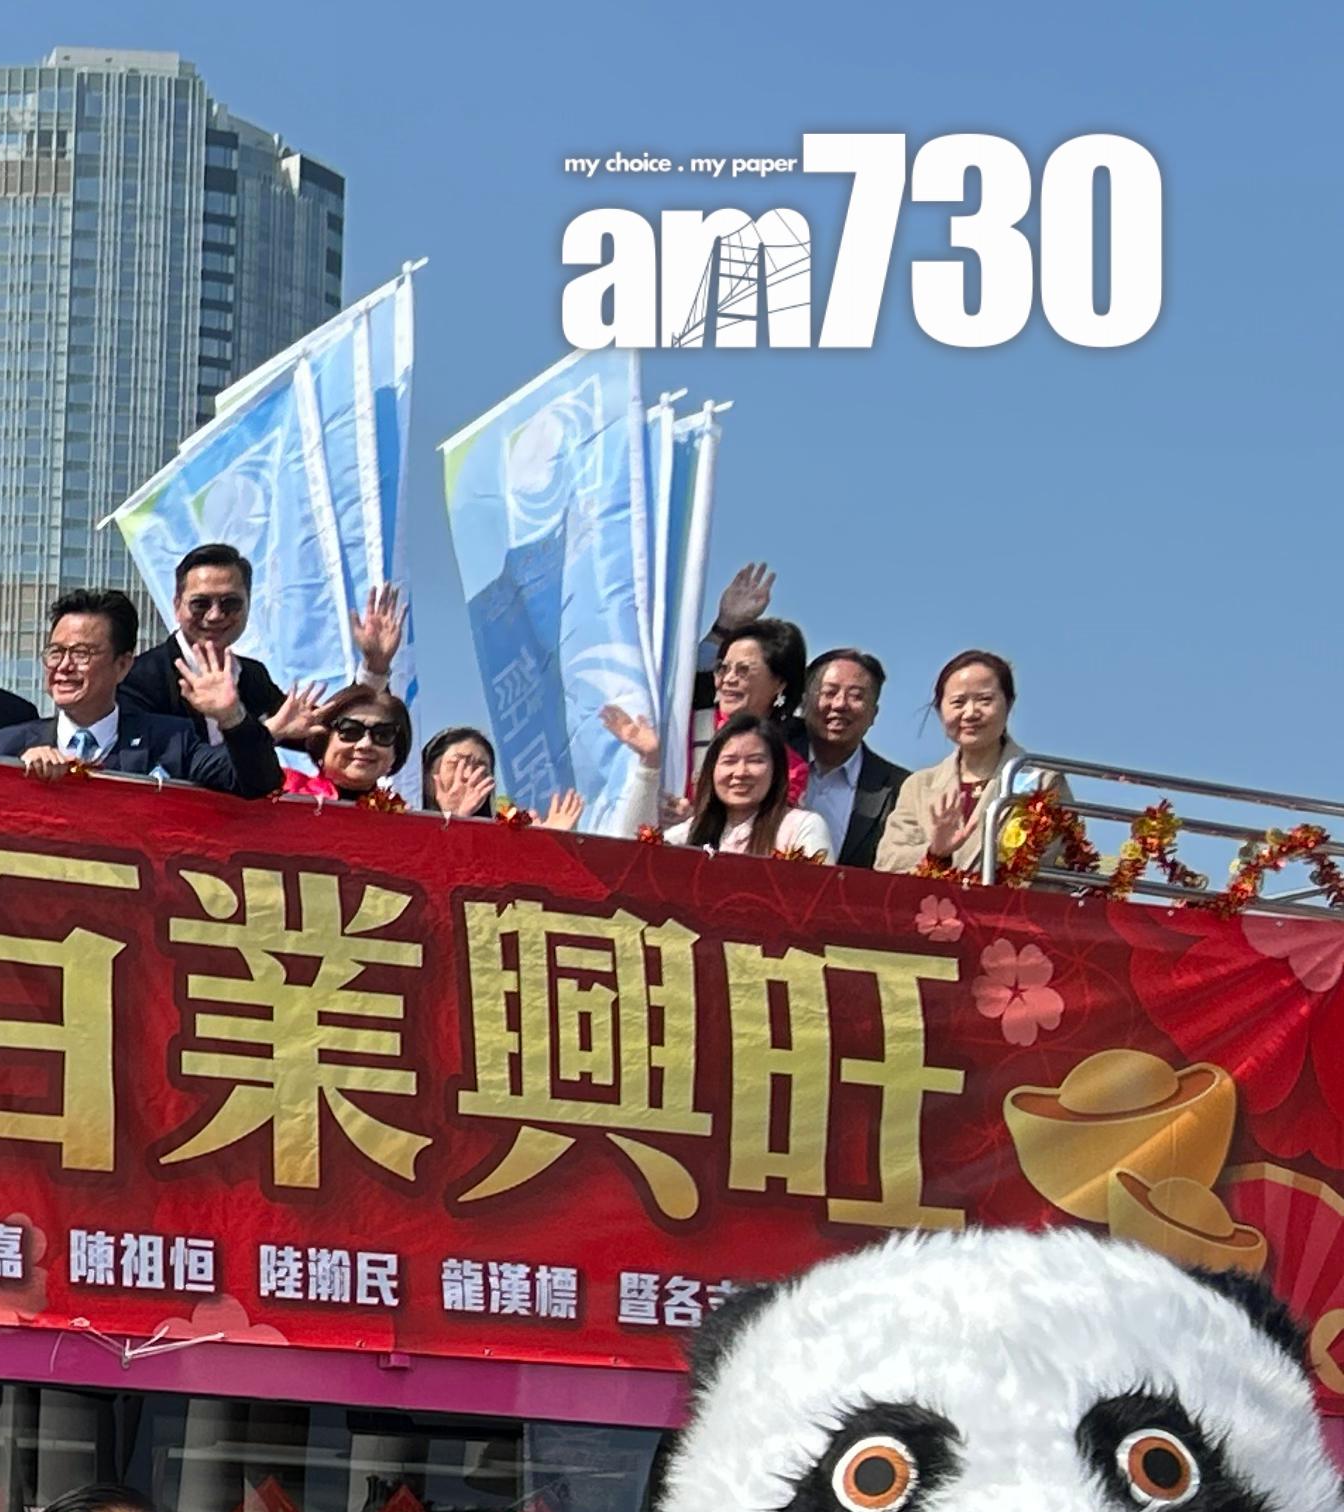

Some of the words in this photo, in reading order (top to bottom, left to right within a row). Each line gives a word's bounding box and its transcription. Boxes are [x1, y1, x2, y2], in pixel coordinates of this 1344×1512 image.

[69, 1229, 216, 1293] 陳祖恒
[259, 1244, 400, 1308] 陸瀚民
[442, 1258, 579, 1321] 龍漢標
